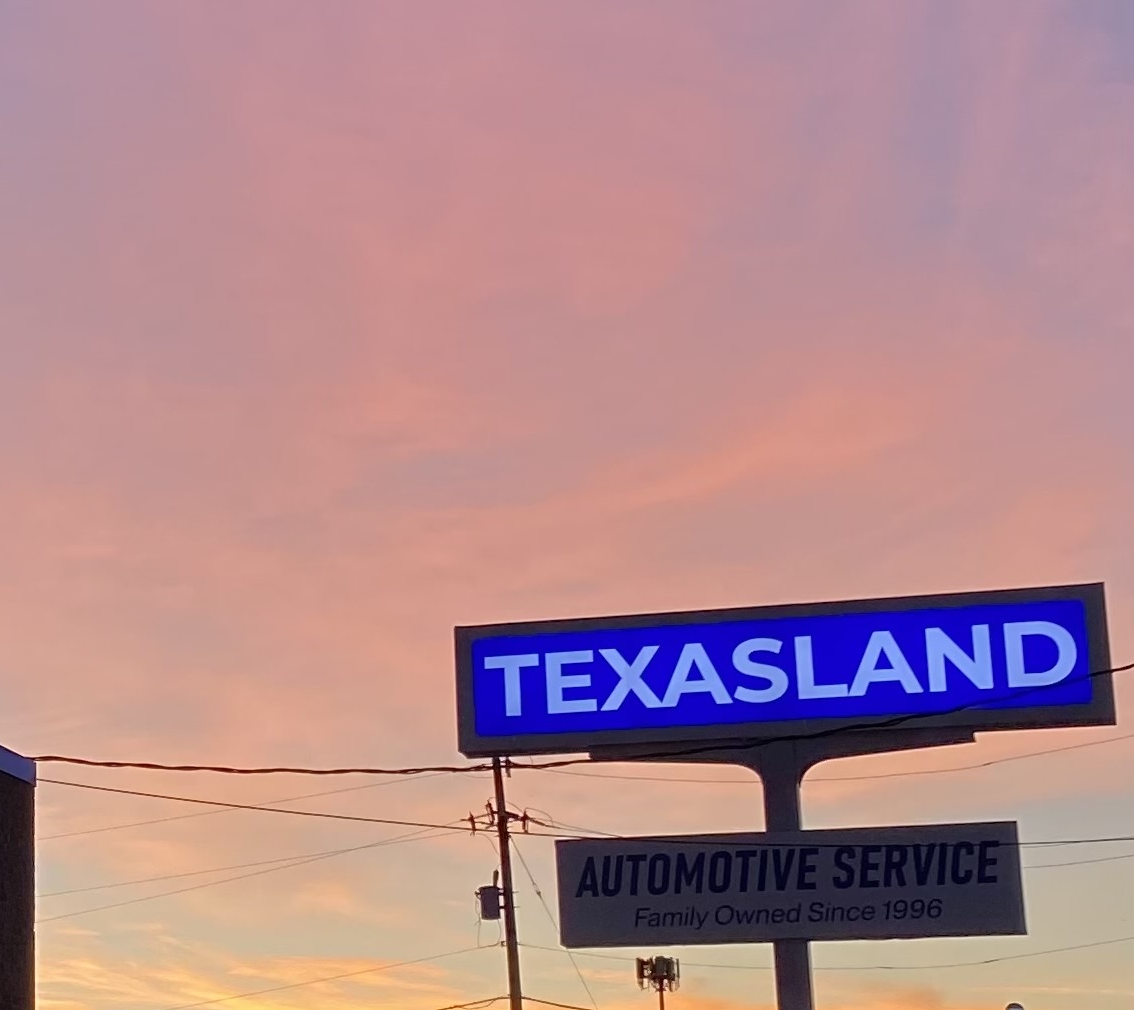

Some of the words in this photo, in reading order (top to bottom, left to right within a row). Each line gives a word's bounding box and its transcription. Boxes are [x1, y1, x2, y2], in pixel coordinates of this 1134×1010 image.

[484, 620, 1077, 717] TEXASLAND
[576, 847, 818, 898] AUTOMOTIVE
[832, 840, 1001, 889] SERVICE
[634, 906, 707, 930] Family
[714, 902, 801, 925] Owned
[808, 901, 876, 923] Since
[883, 898, 943, 920] 1996
